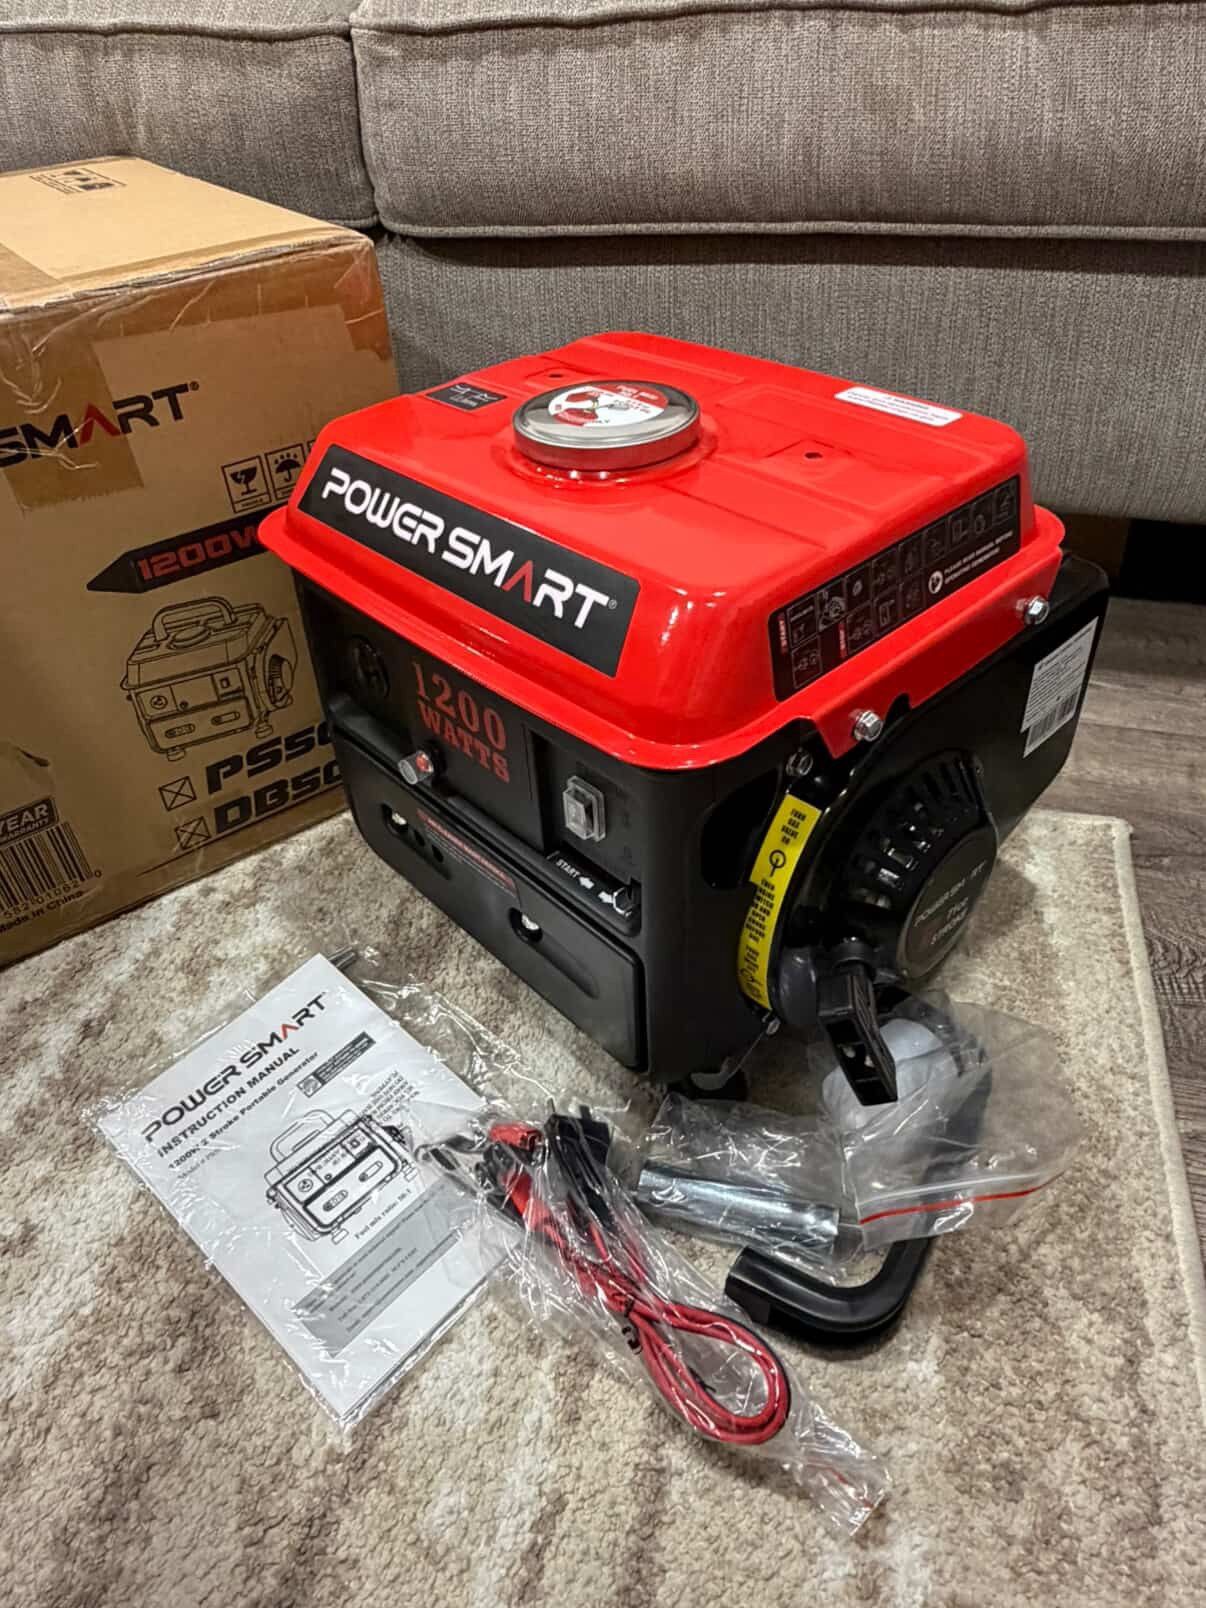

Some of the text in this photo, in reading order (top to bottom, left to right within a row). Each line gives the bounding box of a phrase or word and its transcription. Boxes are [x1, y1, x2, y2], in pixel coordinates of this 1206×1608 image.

[322, 467, 444, 553] POWER
[412, 661, 507, 750] 1200
[418, 701, 509, 783] WATTS
[32, 909, 45, 917] in
[46, 890, 83, 910] China
[555, 859, 580, 878] START
[142, 1064, 242, 1143] POWER
[158, 1087, 246, 1158] INSTRUCTION
[249, 1047, 300, 1090] MANUAL
[208, 1113, 240, 1140] Stroke
[239, 1084, 277, 1116] Portable
[276, 1051, 319, 1087] Generator
